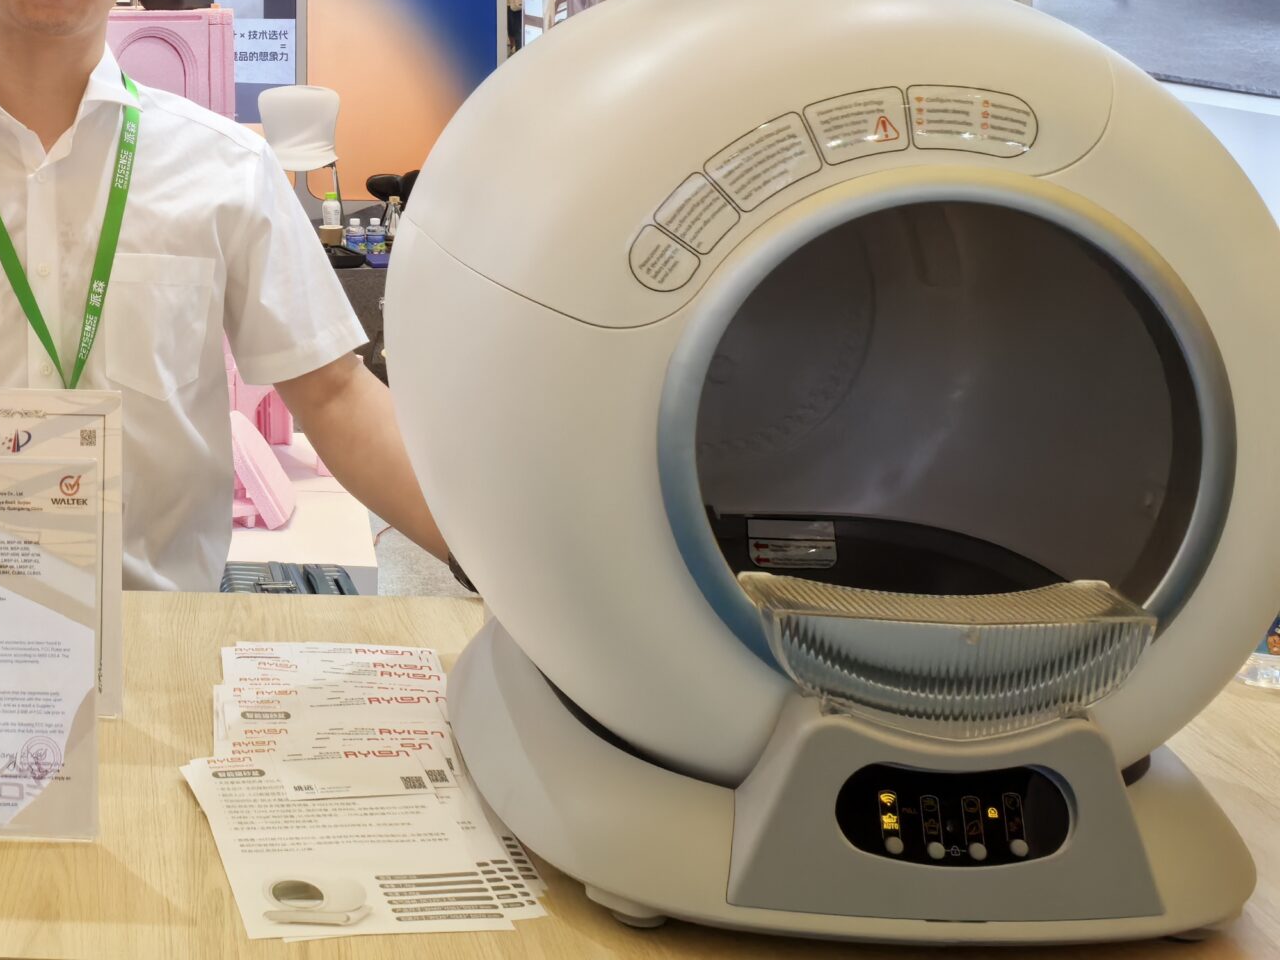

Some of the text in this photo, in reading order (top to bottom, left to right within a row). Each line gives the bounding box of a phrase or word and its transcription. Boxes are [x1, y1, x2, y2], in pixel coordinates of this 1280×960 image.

[248, 30, 288, 40] 技术迭代
[124, 122, 138, 145] 派森
[115, 150, 130, 189] PETSENSE
[90, 280, 106, 308] 派森
[78, 314, 94, 360] PETSENSE
[51, 498, 88, 506] WALTEK
